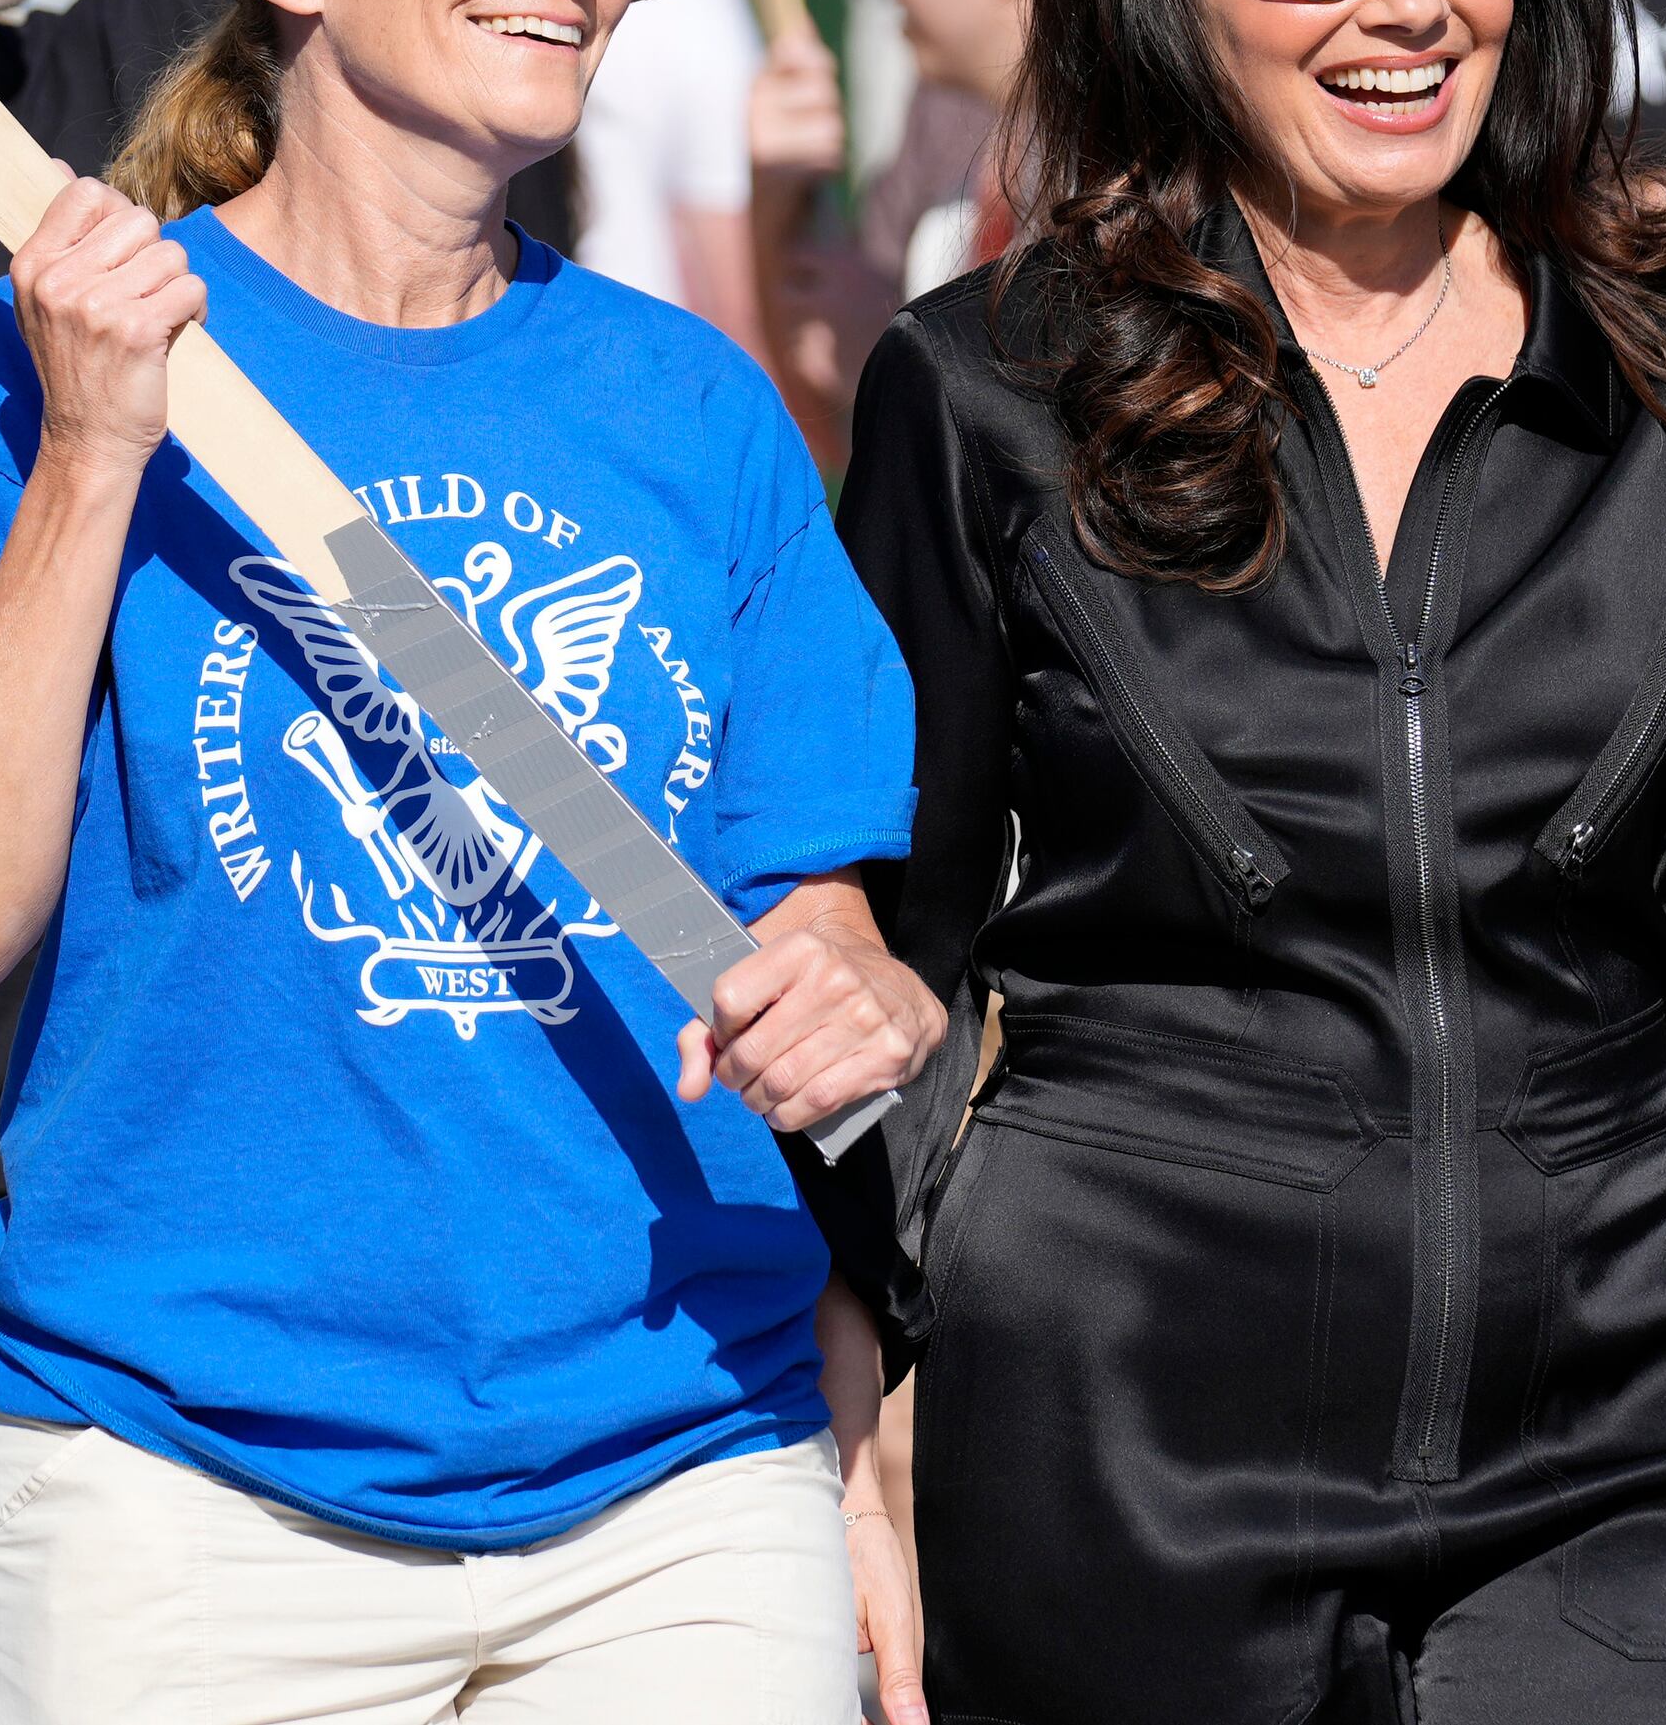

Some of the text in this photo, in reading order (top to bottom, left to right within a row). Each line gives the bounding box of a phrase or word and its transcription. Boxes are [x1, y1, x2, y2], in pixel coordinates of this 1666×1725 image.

[192, 619, 271, 903] WRITERS
[503, 491, 582, 550] OF
[417, 965, 517, 997] WEST
